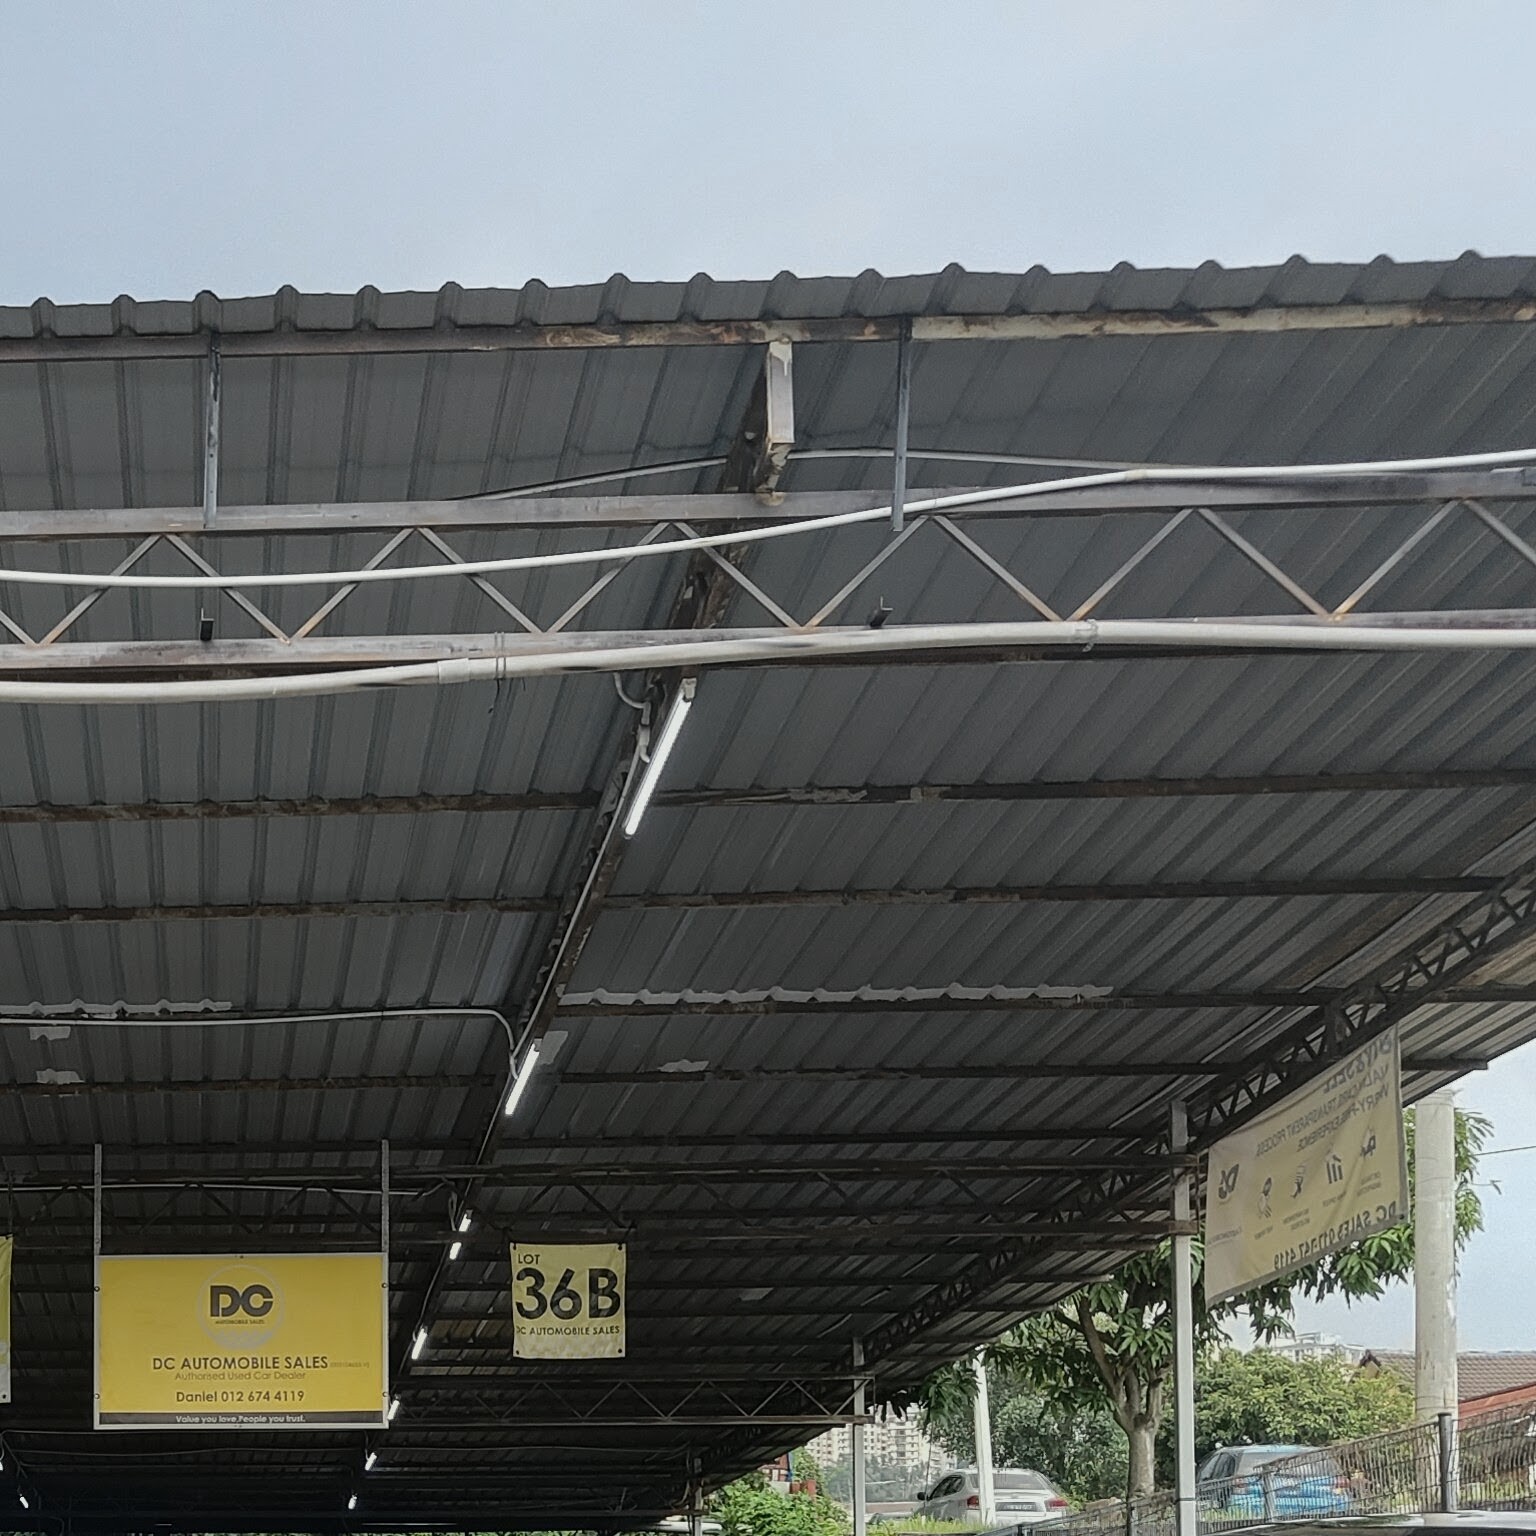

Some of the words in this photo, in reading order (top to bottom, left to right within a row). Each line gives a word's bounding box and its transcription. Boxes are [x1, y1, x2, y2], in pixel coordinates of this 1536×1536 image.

[517, 1254, 540, 1265] LOT
[515, 1267, 621, 1320] 36B
[210, 1284, 273, 1317] DC
[529, 1326, 590, 1336] AUTOMOBILE
[592, 1325, 620, 1335] SALES
[153, 1357, 175, 1370] DC
[181, 1357, 280, 1370] AUTOMOBILE
[284, 1356, 328, 1369] SALES
[228, 1372, 251, 1380] Used
[253, 1371, 272, 1380] Car
[274, 1371, 305, 1380] Dealer
[176, 1391, 217, 1402] Daniel
[221, 1391, 244, 1402] 012
[248, 1391, 270, 1402] 674
[274, 1390, 305, 1401] 4119
[176, 1415, 199, 1423] Value
[201, 1416, 217, 1425] you
[269, 1416, 284, 1424] you
